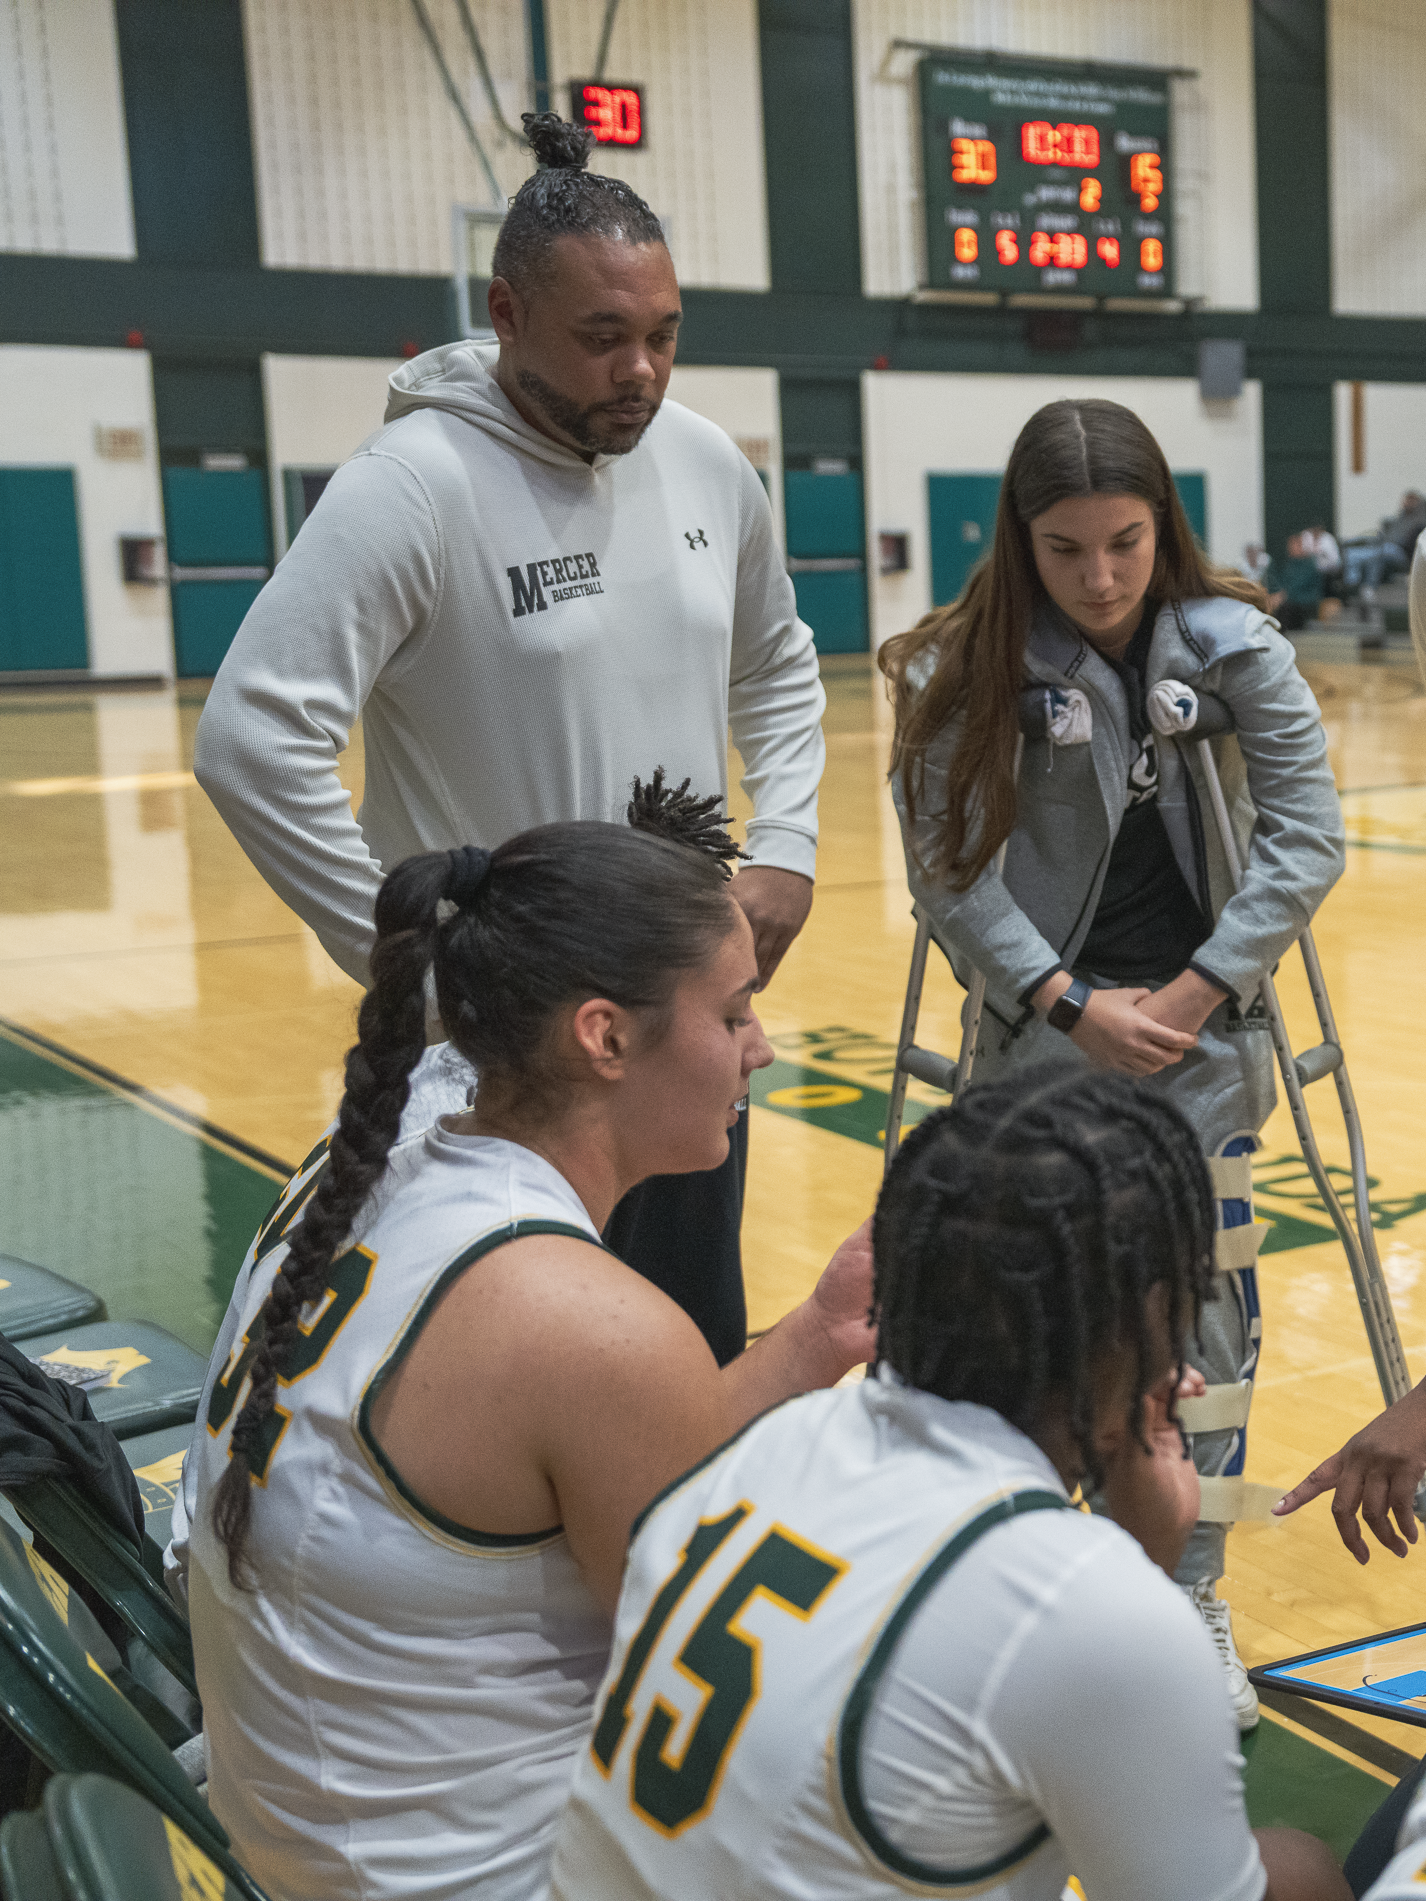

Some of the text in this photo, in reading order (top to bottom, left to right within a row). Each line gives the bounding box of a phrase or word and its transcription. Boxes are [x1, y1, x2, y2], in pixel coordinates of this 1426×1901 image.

[582, 86, 642, 145] 30
[951, 137, 997, 185] 30
[507, 552, 601, 618] MERCER
[552, 581, 604, 603] BASKETBALL
[590, 1498, 852, 1840] 15
